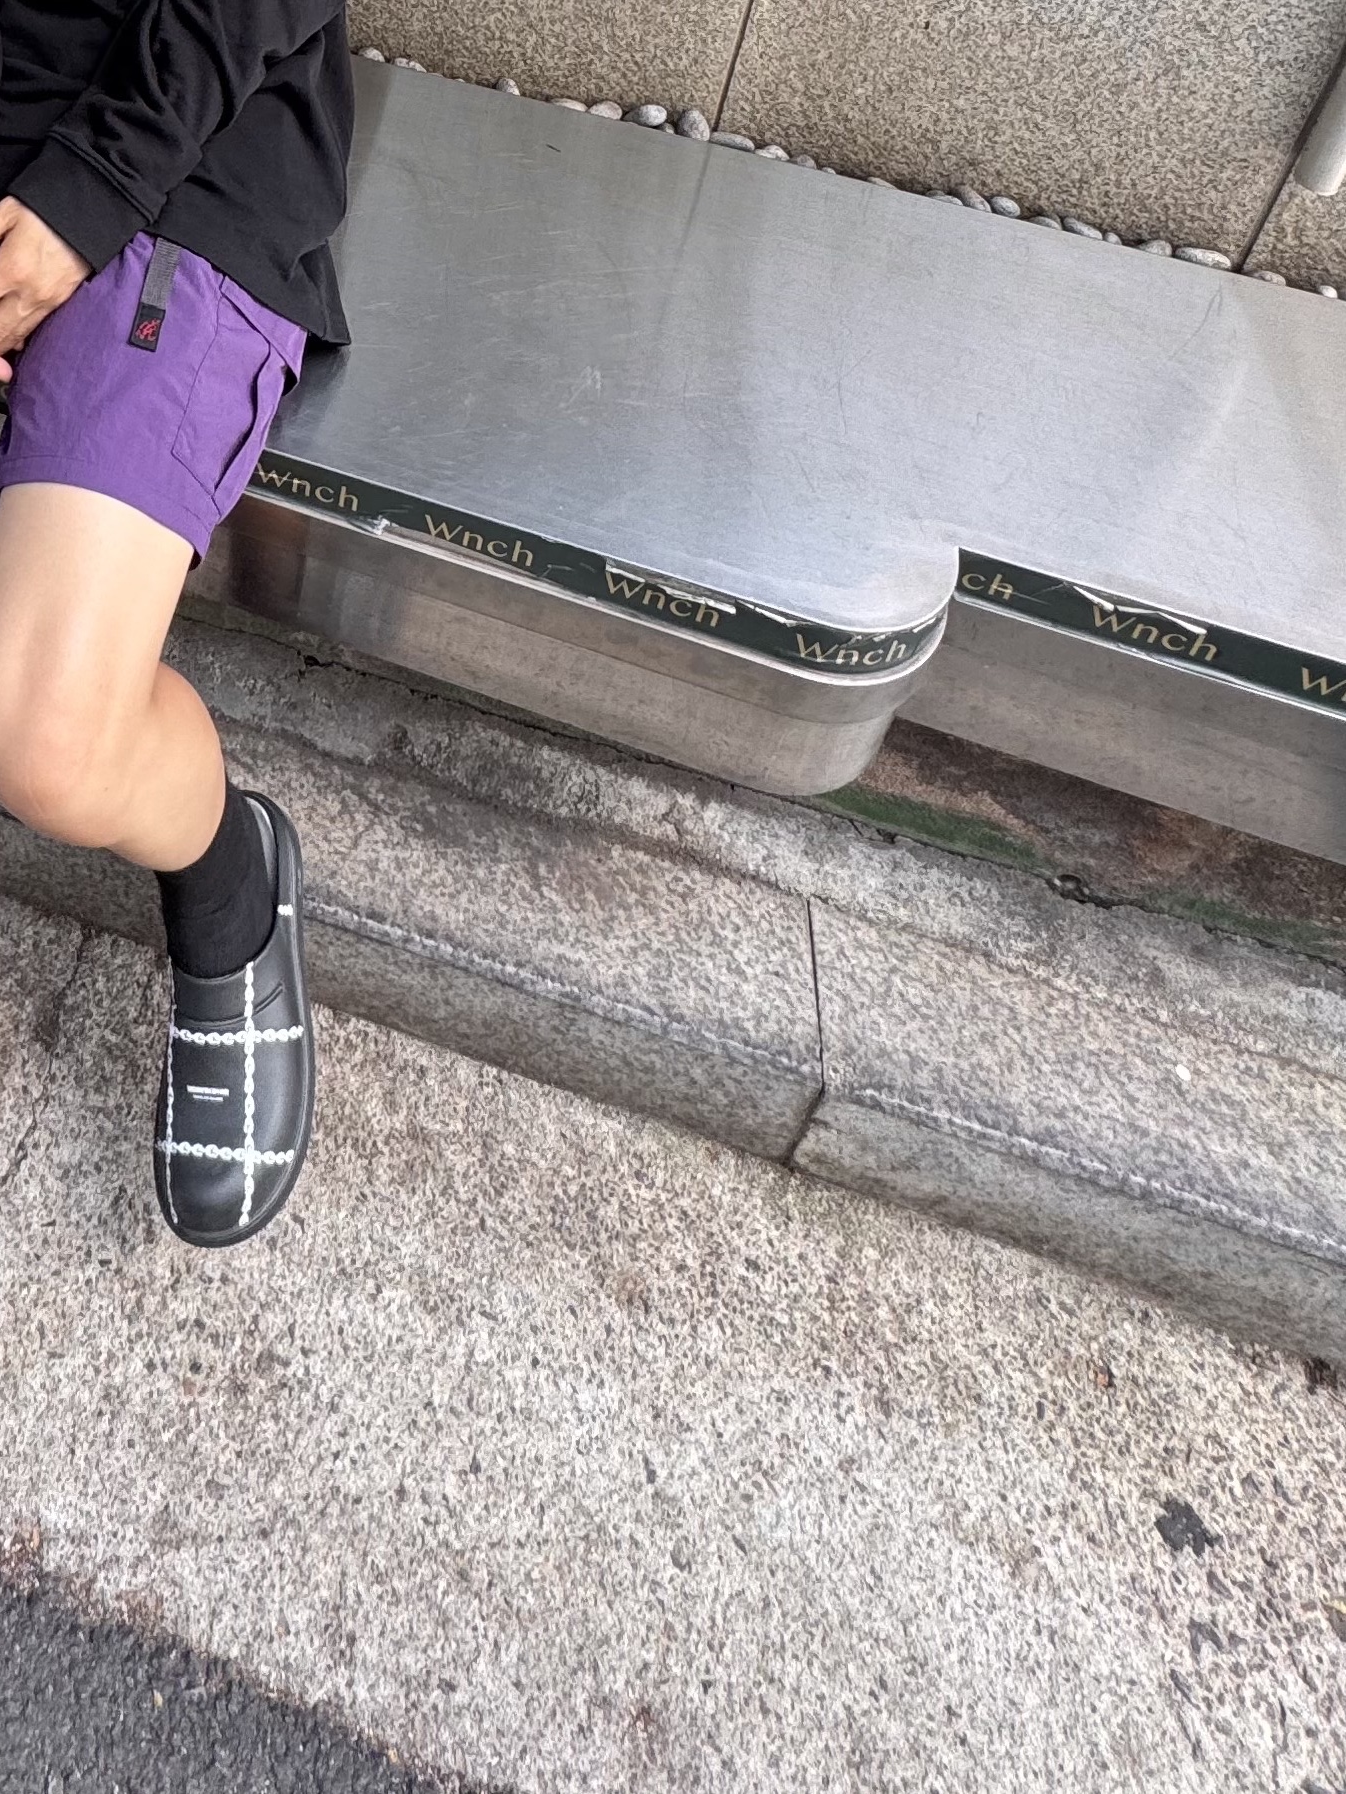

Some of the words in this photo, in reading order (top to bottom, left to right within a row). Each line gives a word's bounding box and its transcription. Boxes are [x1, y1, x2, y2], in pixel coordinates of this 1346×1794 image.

[257, 462, 359, 512] Wnch
[424, 514, 534, 567] Wnch
[605, 570, 720, 627] Wnch
[796, 633, 907, 667] Wnch
[1091, 605, 1218, 661] Wnch
